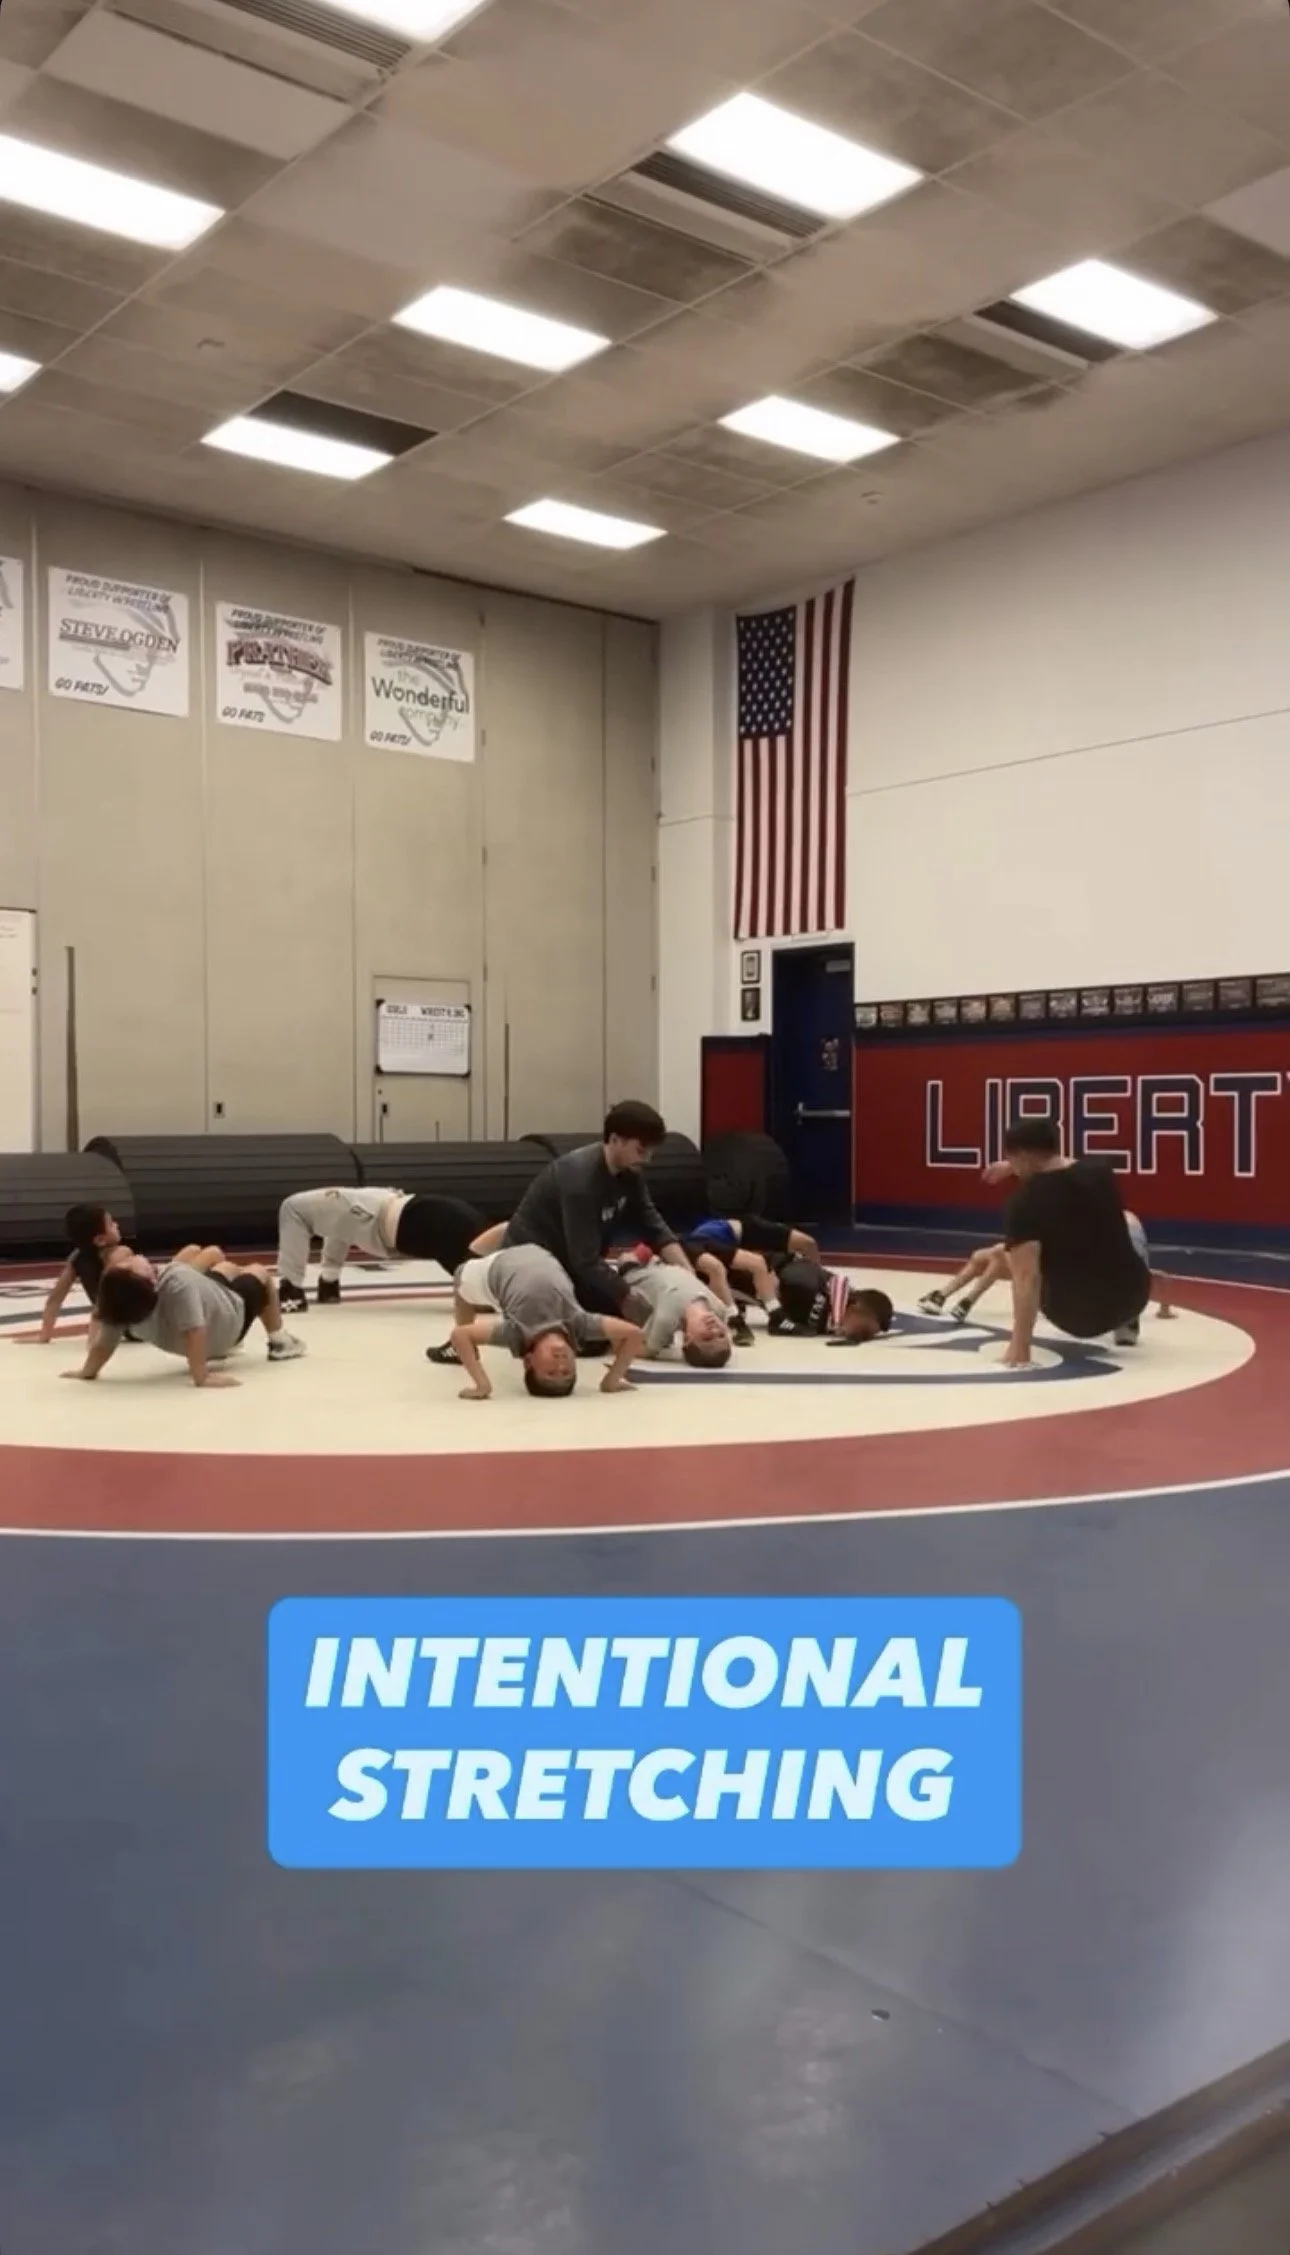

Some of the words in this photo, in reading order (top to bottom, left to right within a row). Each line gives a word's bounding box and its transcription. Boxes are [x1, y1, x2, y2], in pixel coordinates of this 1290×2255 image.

[60, 617, 118, 640] STEVE
[120, 628, 179, 654] OGDEN
[371, 676, 470, 715] Wonderful
[926, 1072, 1290, 1177] LIBERT
